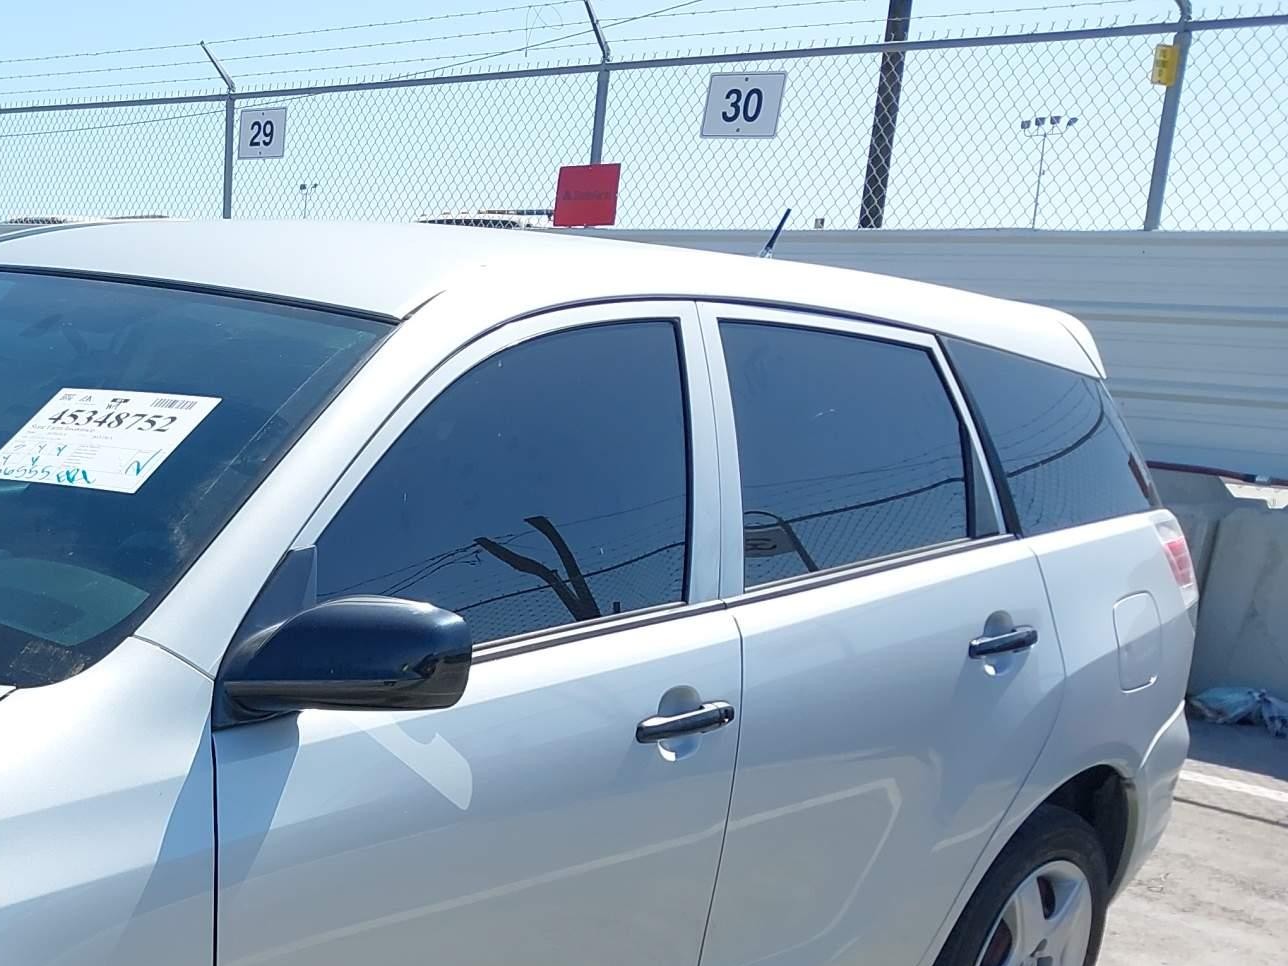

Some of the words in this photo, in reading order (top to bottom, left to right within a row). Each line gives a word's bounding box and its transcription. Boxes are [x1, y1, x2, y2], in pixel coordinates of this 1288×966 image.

[721, 87, 764, 123] 30
[248, 120, 275, 148] 29
[48, 408, 178, 433] 45348752
